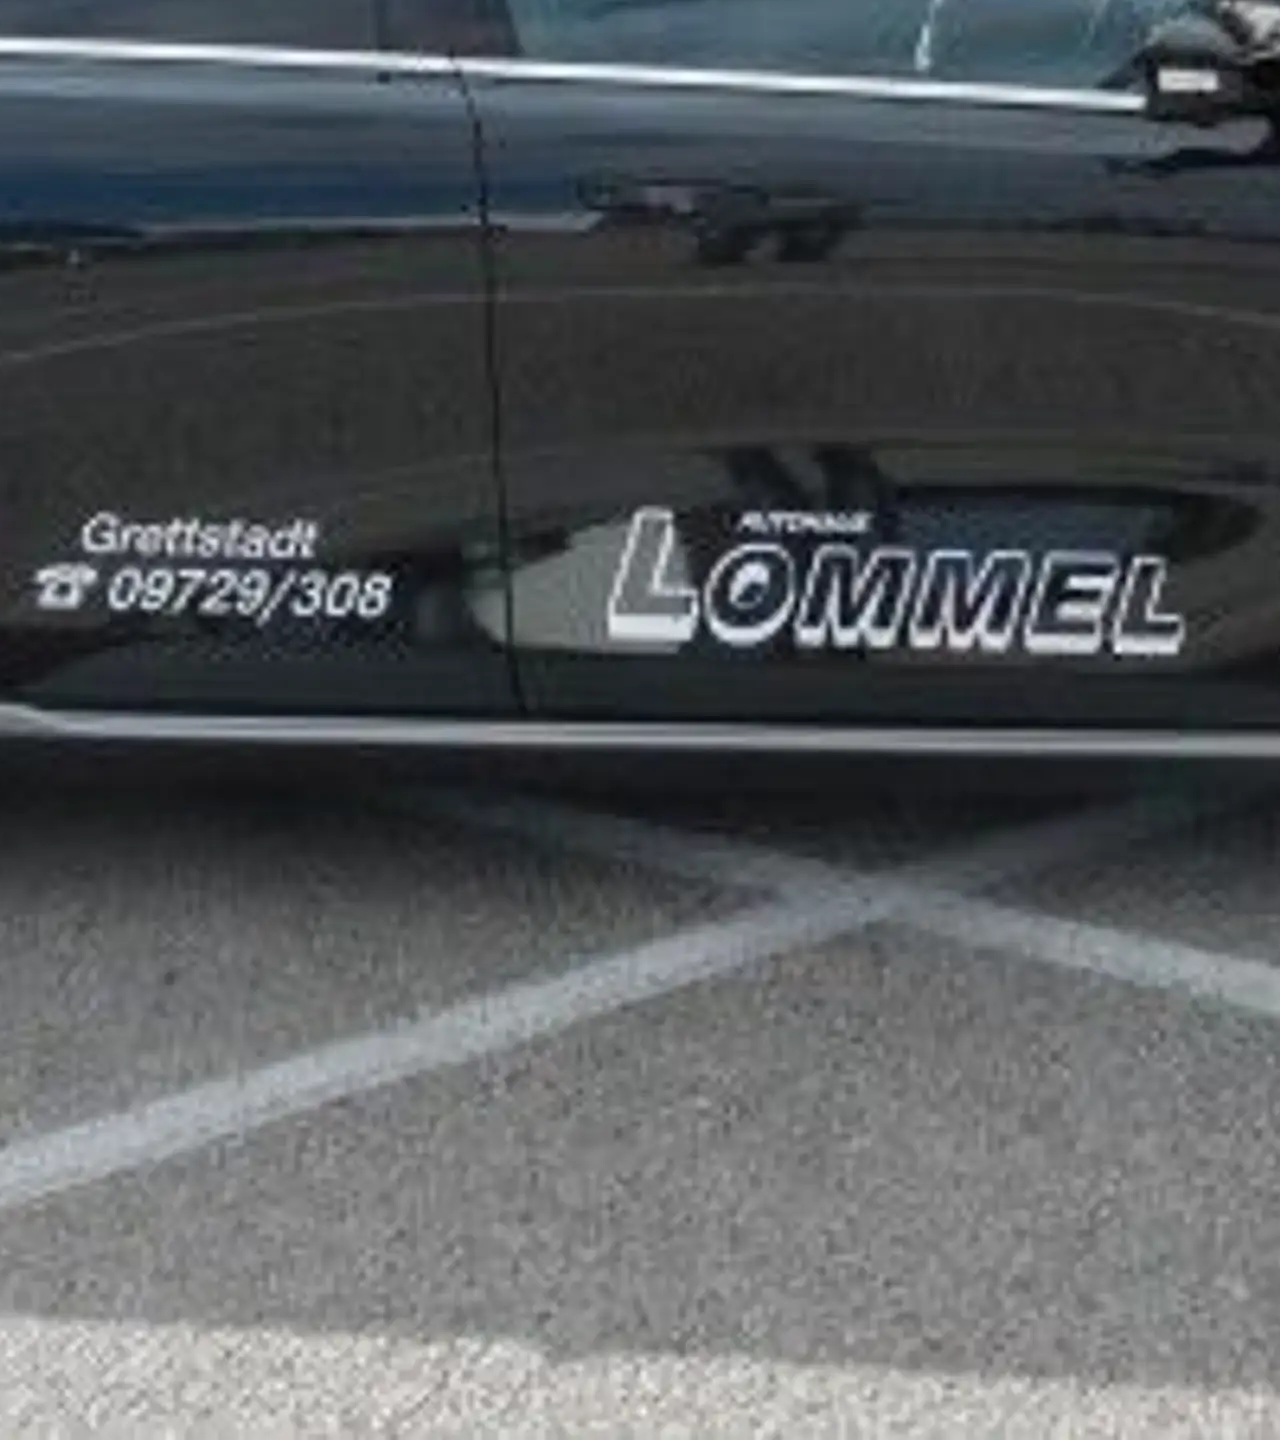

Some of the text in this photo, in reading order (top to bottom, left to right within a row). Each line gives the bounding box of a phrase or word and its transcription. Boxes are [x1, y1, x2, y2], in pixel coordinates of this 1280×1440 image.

[80, 511, 320, 559] Grettstadt
[107, 569, 393, 627] 09729/308
[606, 506, 1187, 655] LOMMEL
